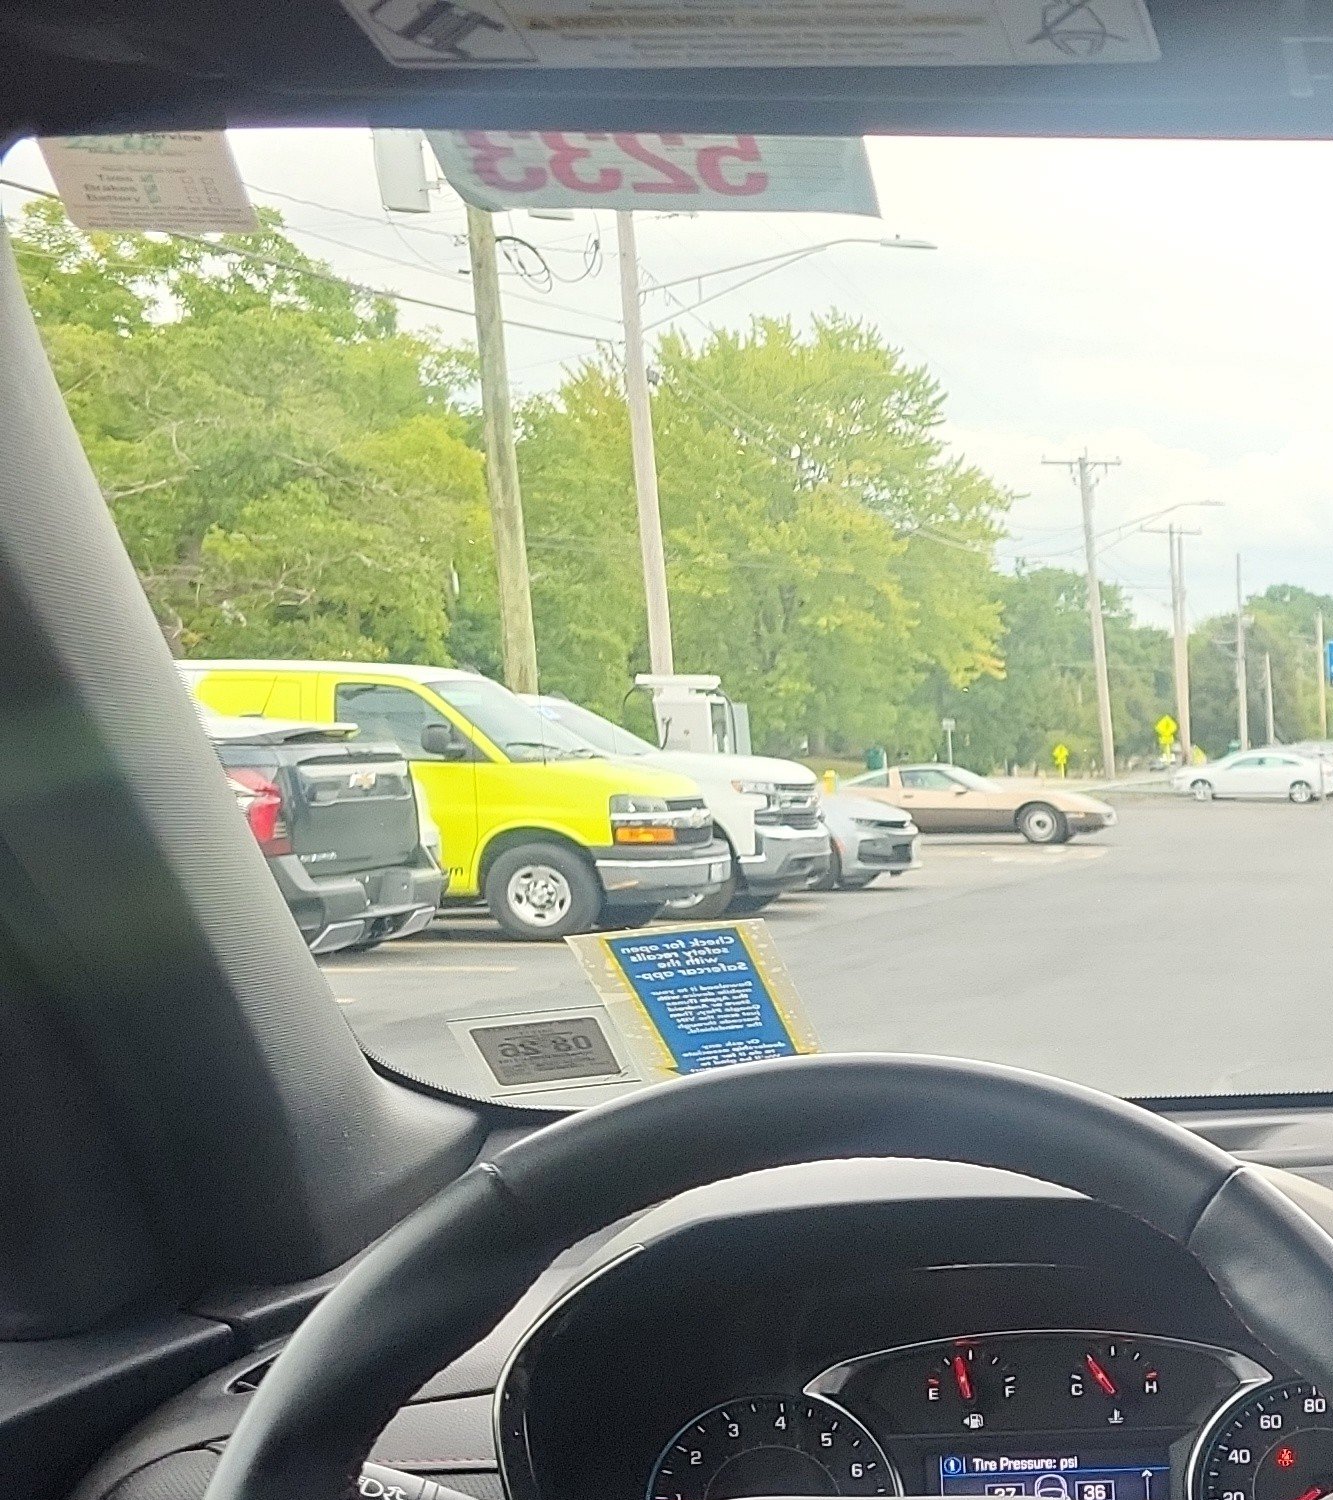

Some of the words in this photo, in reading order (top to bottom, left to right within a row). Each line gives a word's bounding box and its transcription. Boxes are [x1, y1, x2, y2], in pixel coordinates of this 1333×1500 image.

[928, 1388, 940, 1401] E
[1005, 1385, 1015, 1398] F
[1071, 1384, 1083, 1396] C
[1145, 1381, 1157, 1394] H
[1304, 1399, 1326, 1413] 80
[775, 1416, 787, 1430] 4
[1260, 1415, 1282, 1429] 60
[728, 1423, 739, 1438] 3
[820, 1433, 832, 1447] 5
[690, 1451, 702, 1465] 2
[972, 1458, 997, 1471] Tire
[1000, 1456, 1057, 1471] Pressure:
[1060, 1455, 1078, 1471] psi
[1228, 1449, 1251, 1464] 40
[851, 1463, 863, 1478] 6
[1083, 1486, 1106, 1500] 36
